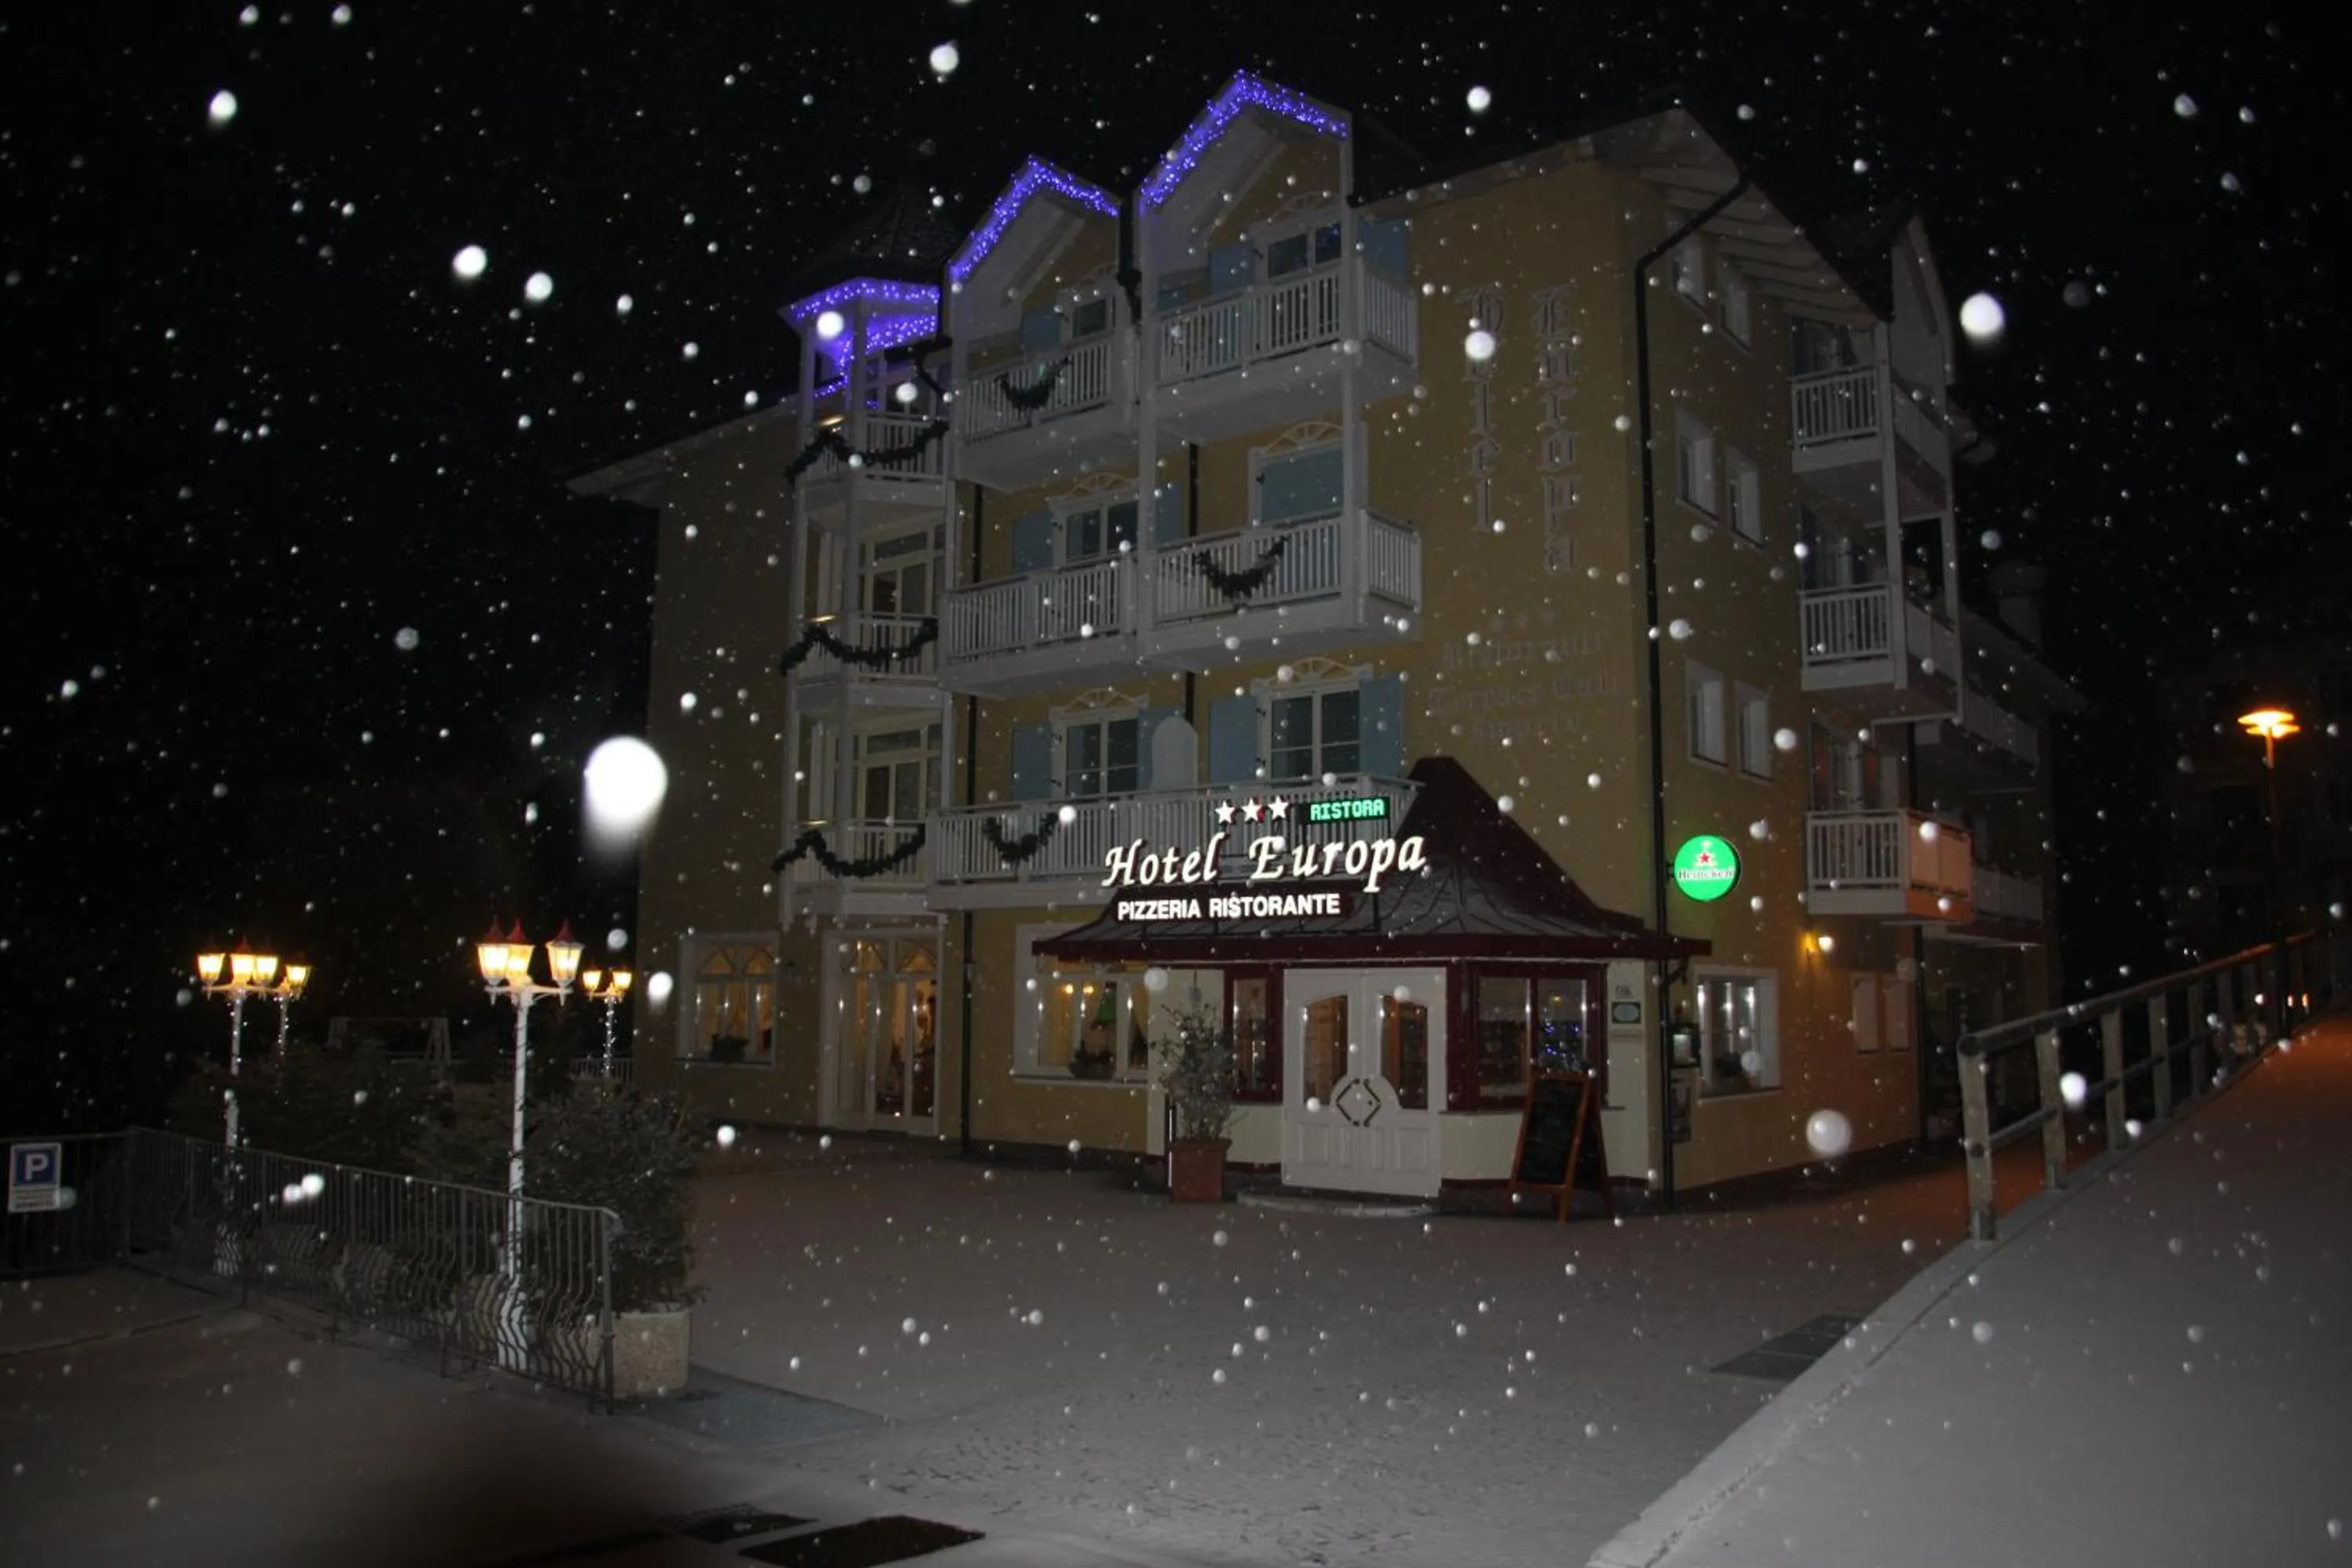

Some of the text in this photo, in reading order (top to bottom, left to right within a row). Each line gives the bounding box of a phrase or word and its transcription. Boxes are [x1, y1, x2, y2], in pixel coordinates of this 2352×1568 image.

[1310, 798, 1385, 822] RISTORA
[1101, 832, 1427, 893] Hotel Europa
[1117, 893, 1341, 921] PIZZERIA RISTORANTE
[24, 1153, 49, 1181] P
